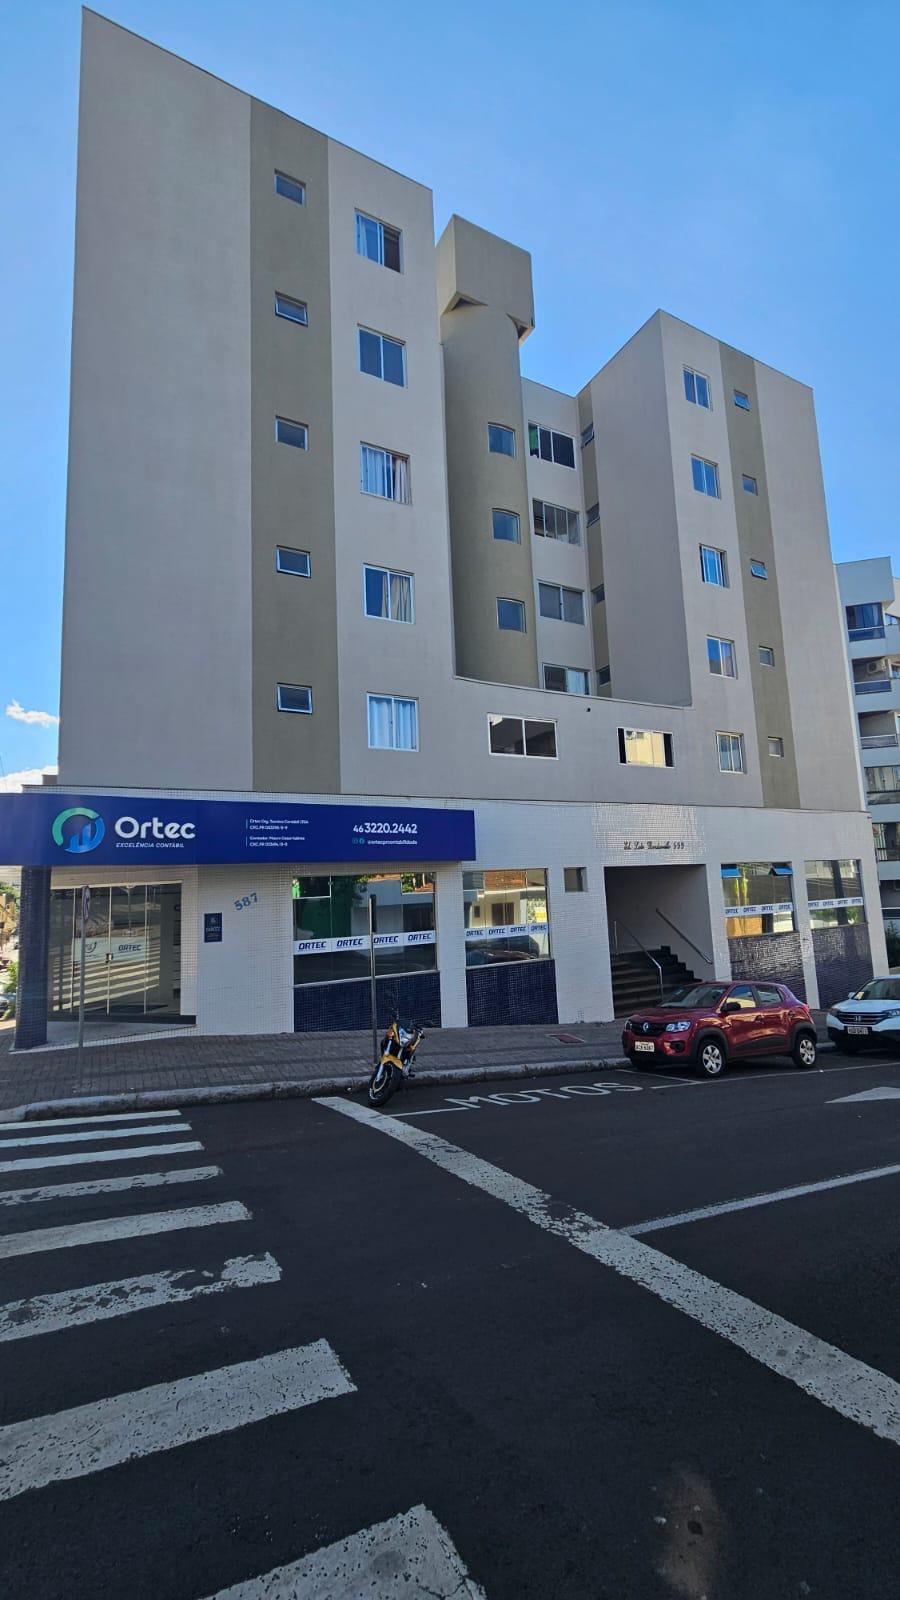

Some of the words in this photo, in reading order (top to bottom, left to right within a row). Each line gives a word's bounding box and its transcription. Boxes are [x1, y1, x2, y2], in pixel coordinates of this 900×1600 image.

[115, 816, 196, 839] Ortec
[234, 892, 258, 911] 587
[118, 944, 142, 952] ORTEC
[298, 941, 327, 950] ORTEC
[336, 938, 364, 947] ORTEC
[373, 935, 399, 944] ORTEC
[407, 932, 432, 941] ORTEC
[444, 1082, 644, 1108] MOTOS
